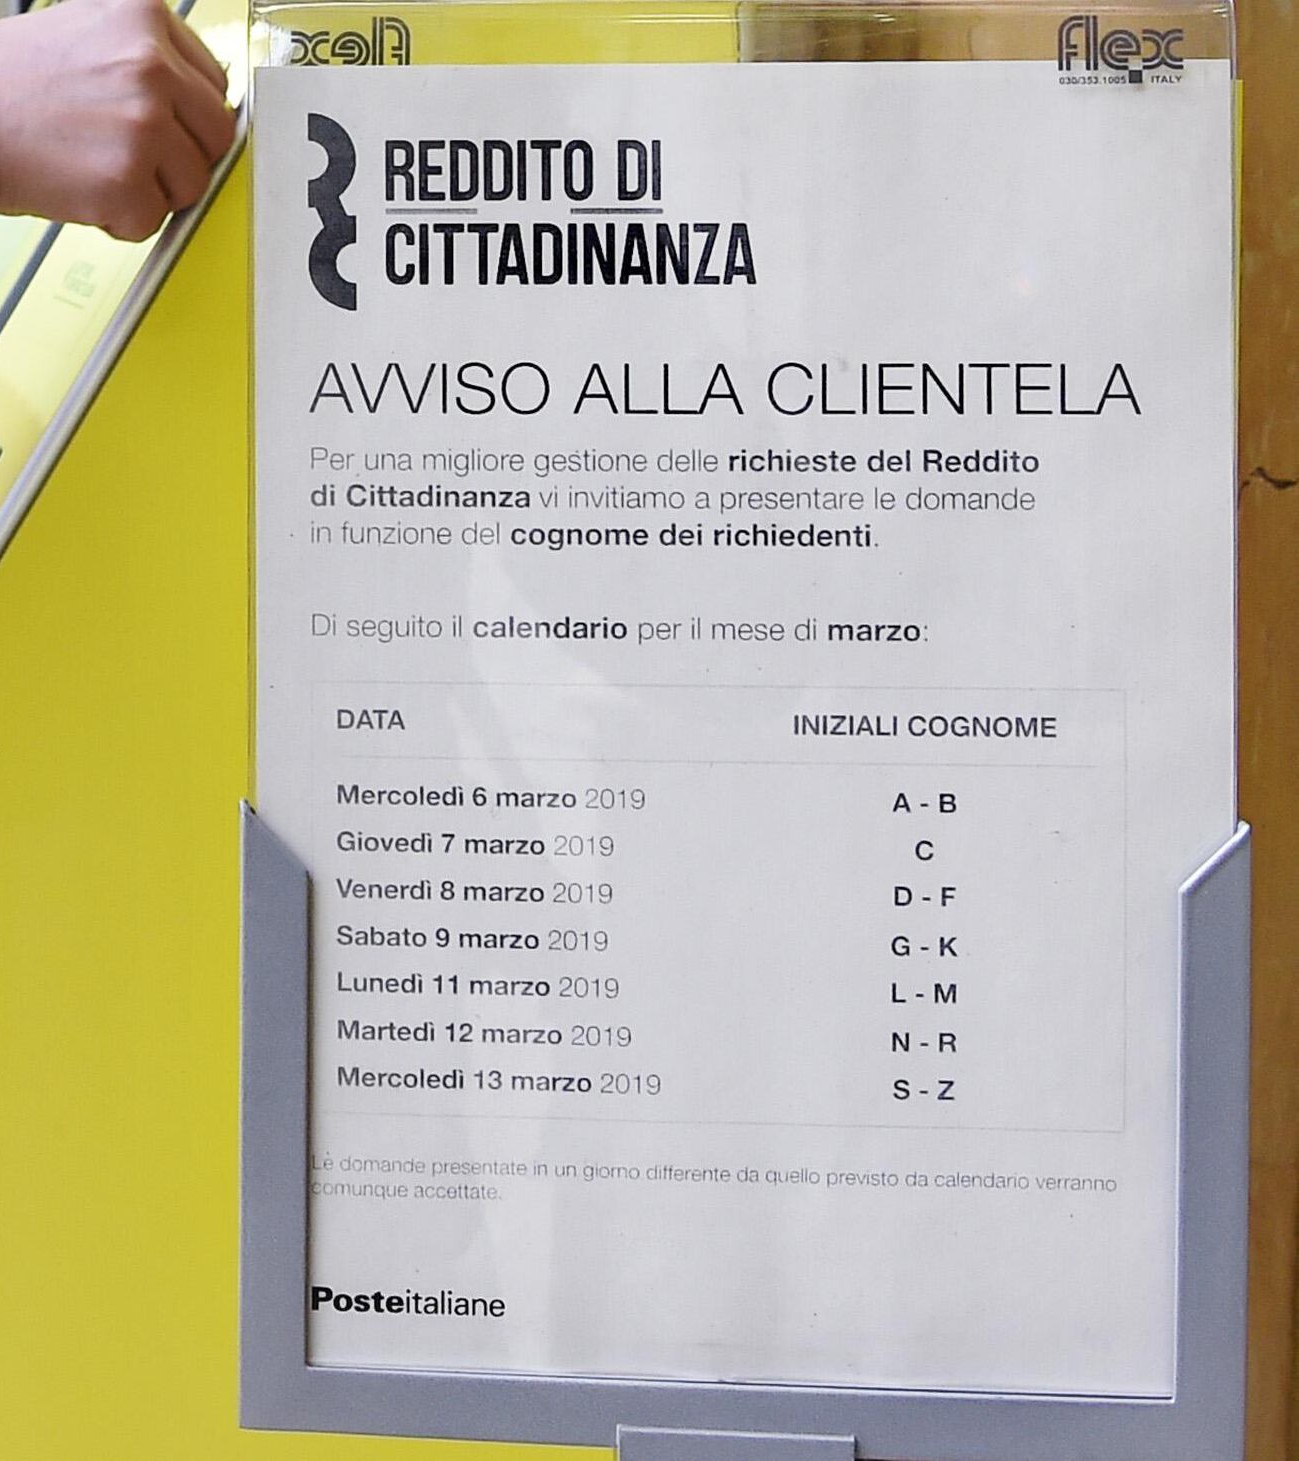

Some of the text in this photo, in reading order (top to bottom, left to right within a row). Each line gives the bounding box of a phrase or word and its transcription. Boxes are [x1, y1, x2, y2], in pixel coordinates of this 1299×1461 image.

[1151, 75, 1181, 83] ITALY
[385, 140, 661, 201] REDDITO DI
[386, 223, 756, 285] CITTADINANZA
[309, 362, 1141, 415] AVVISO ALLA CLIENTELA
[311, 447, 1039, 477] Per una migliore gestione delle richieste del Reddito
[311, 484, 1035, 514] di Cittadinanza vi invitiamo a presentare le domande
[311, 521, 878, 550] in funzione del cognome dei richiedenti.
[312, 613, 927, 645] Di seguito il calendario per il mese di marzo:
[337, 709, 405, 730] DATA
[794, 715, 1057, 738] INIZIALI COGNOME
[338, 785, 645, 810] Mercoledì 6 marzo 2019
[893, 793, 911, 813] A
[939, 793, 956, 813] B
[337, 831, 614, 857] Giovedì 7 marzo 2019
[915, 840, 933, 861] C
[336, 878, 612, 904] Venerdì 8 marzo 2019
[894, 886, 912, 906] D
[941, 887, 956, 907] F
[337, 925, 608, 951] Sabato 9 marzo 2019
[891, 936, 910, 956] G
[940, 937, 957, 957] K
[338, 971, 619, 999] Lunedì 11 marzo 2019
[892, 983, 906, 1003] L
[934, 983, 956, 1003] M
[338, 1020, 631, 1047] Martedì 12 marzo 2019
[892, 1032, 909, 1052] N
[939, 1033, 956, 1052] R
[338, 1066, 661, 1095] Mercoledì 13 marzo 2019
[893, 1079, 910, 1100] S
[938, 1080, 955, 1100] Z
[312, 1156, 1117, 1192] Le domande presentate in un giorno differente da quello previsto da calendario verranno
[311, 1183, 501, 1200] comunque accettate.
